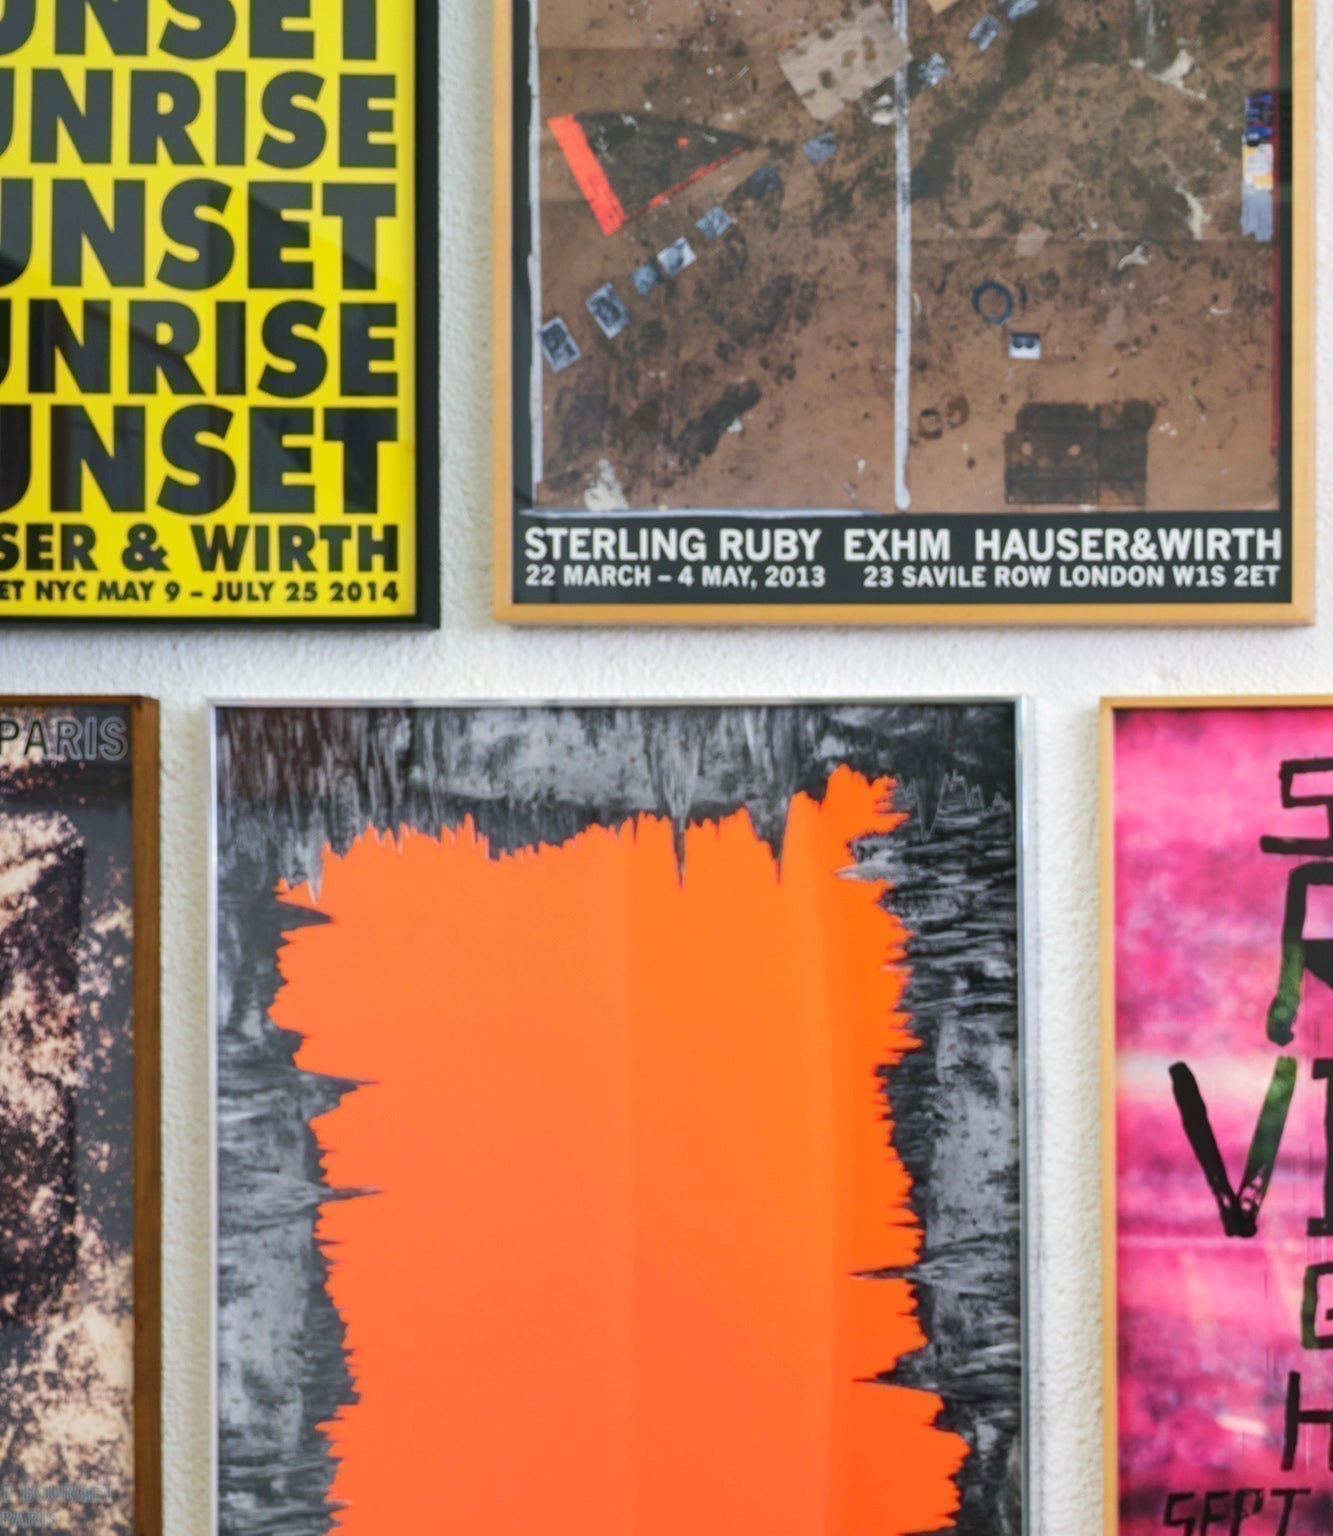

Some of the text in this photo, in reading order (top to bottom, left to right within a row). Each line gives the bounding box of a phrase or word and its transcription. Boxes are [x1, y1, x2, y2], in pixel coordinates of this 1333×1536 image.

[0, 68, 397, 169] NRISE
[0, 298, 398, 399] NRISE
[121, 522, 171, 572] &
[190, 523, 398, 572] WIRTH
[524, 527, 1282, 562] STERLING RUBY EXHM HAUSER&WIRTH
[36, 580, 86, 601] NYC
[98, 580, 153, 601] MAY
[165, 580, 180, 602] 9
[213, 581, 275, 602] JULY
[286, 581, 318, 602] 25
[330, 581, 399, 602] 2014
[525, 565, 555, 587] 22
[563, 565, 651, 587] MARCH
[677, 565, 694, 587] 4
[701, 565, 758, 590] MAY,
[765, 565, 827, 587] 2013
[863, 565, 894, 588] 23
[902, 565, 986, 588] SAVILE
[994, 565, 1052, 588] ROW
[1059, 565, 1164, 588] LONDON
[1173, 565, 1226, 588] W1S
[1234, 565, 1280, 588] 2ET
[0, 716, 129, 762] PARIS
